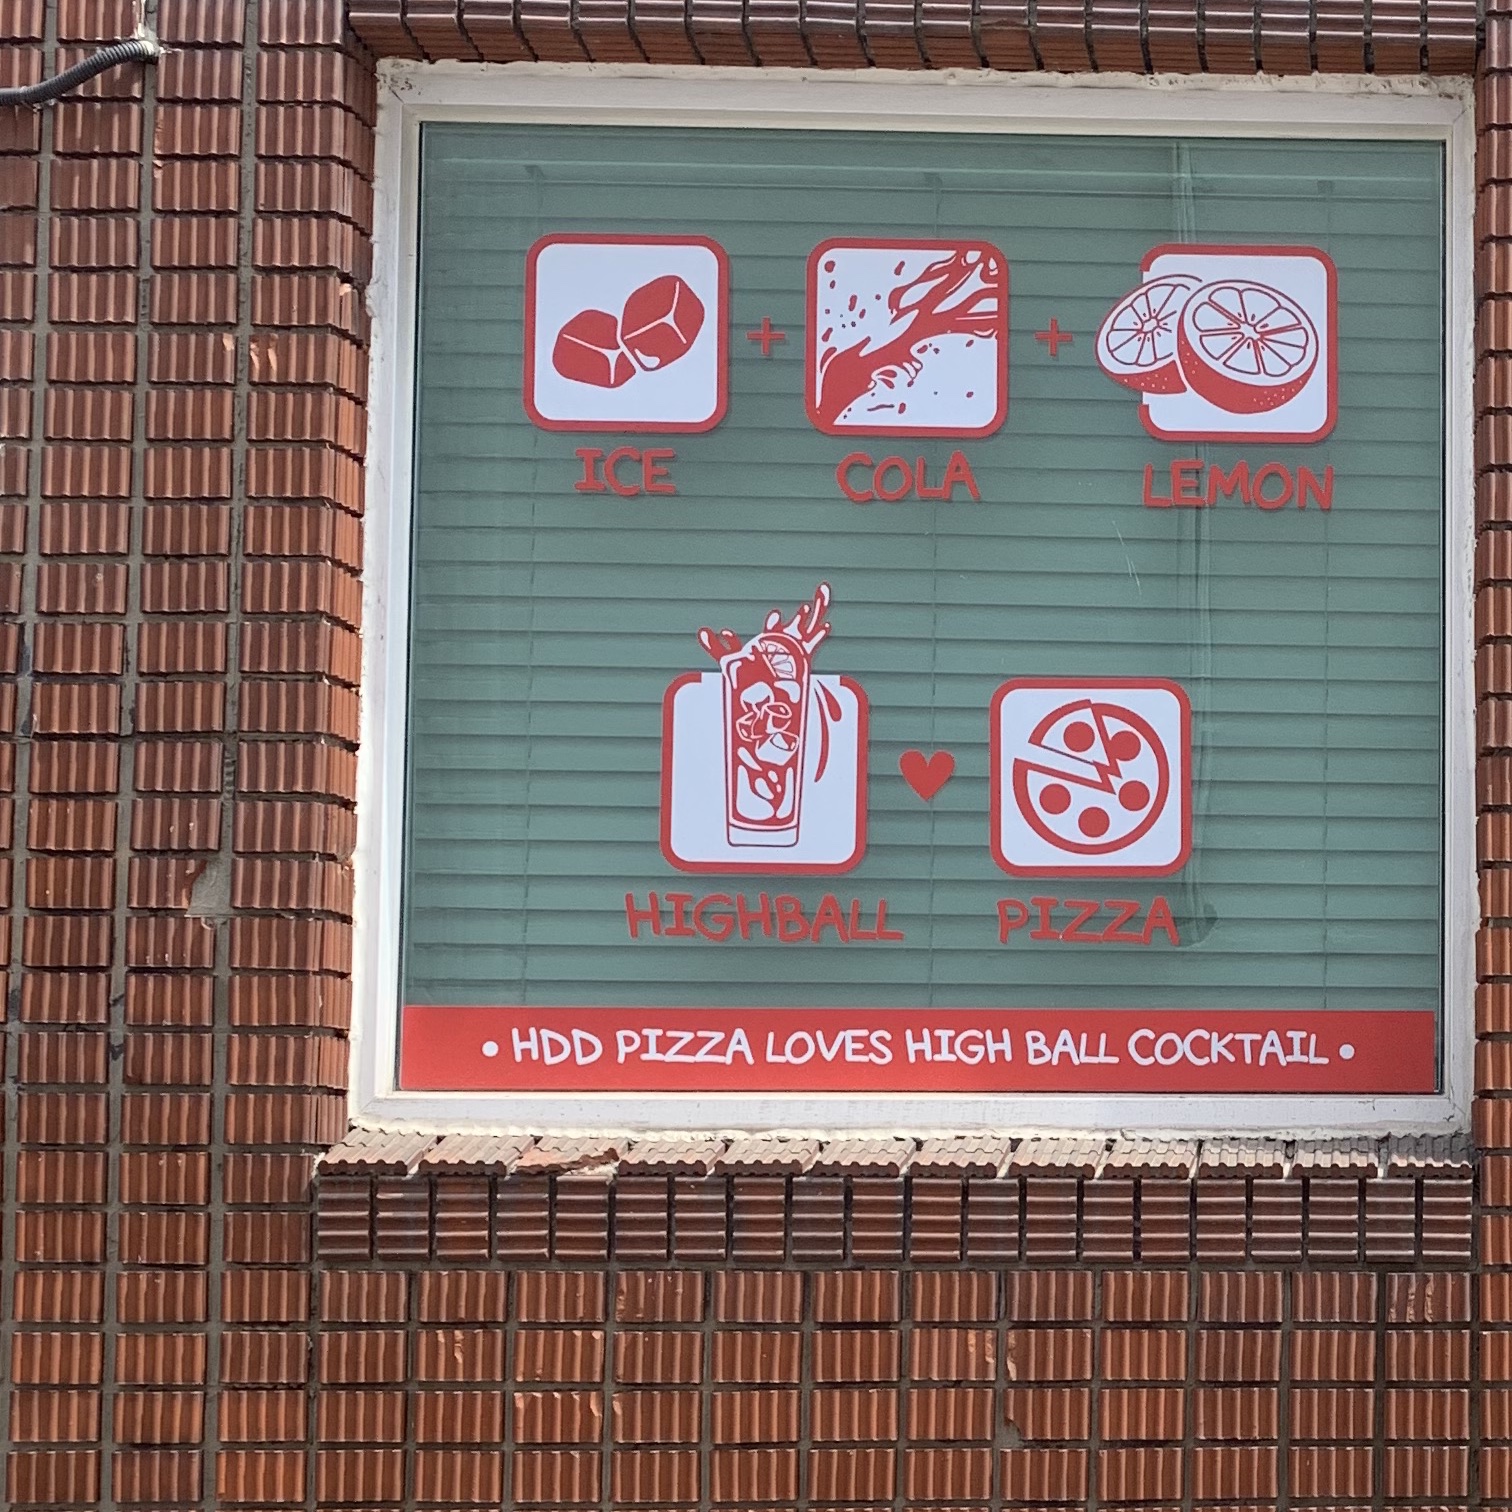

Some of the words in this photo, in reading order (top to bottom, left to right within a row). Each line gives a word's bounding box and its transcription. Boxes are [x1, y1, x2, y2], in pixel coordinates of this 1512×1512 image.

[574, 446, 677, 497] ICE
[835, 450, 981, 502] COLA
[1142, 459, 1334, 511] LEMON
[624, 892, 904, 943] HIGHBALL
[996, 896, 1180, 946] PIZZA
[511, 1026, 603, 1066] HDD
[616, 1027, 755, 1065] PIZZA
[766, 1029, 893, 1065] LOVES
[905, 1028, 1013, 1065] HIGH
[1026, 1029, 1120, 1066] BALL
[1127, 1029, 1330, 1067] COCKTAIL
